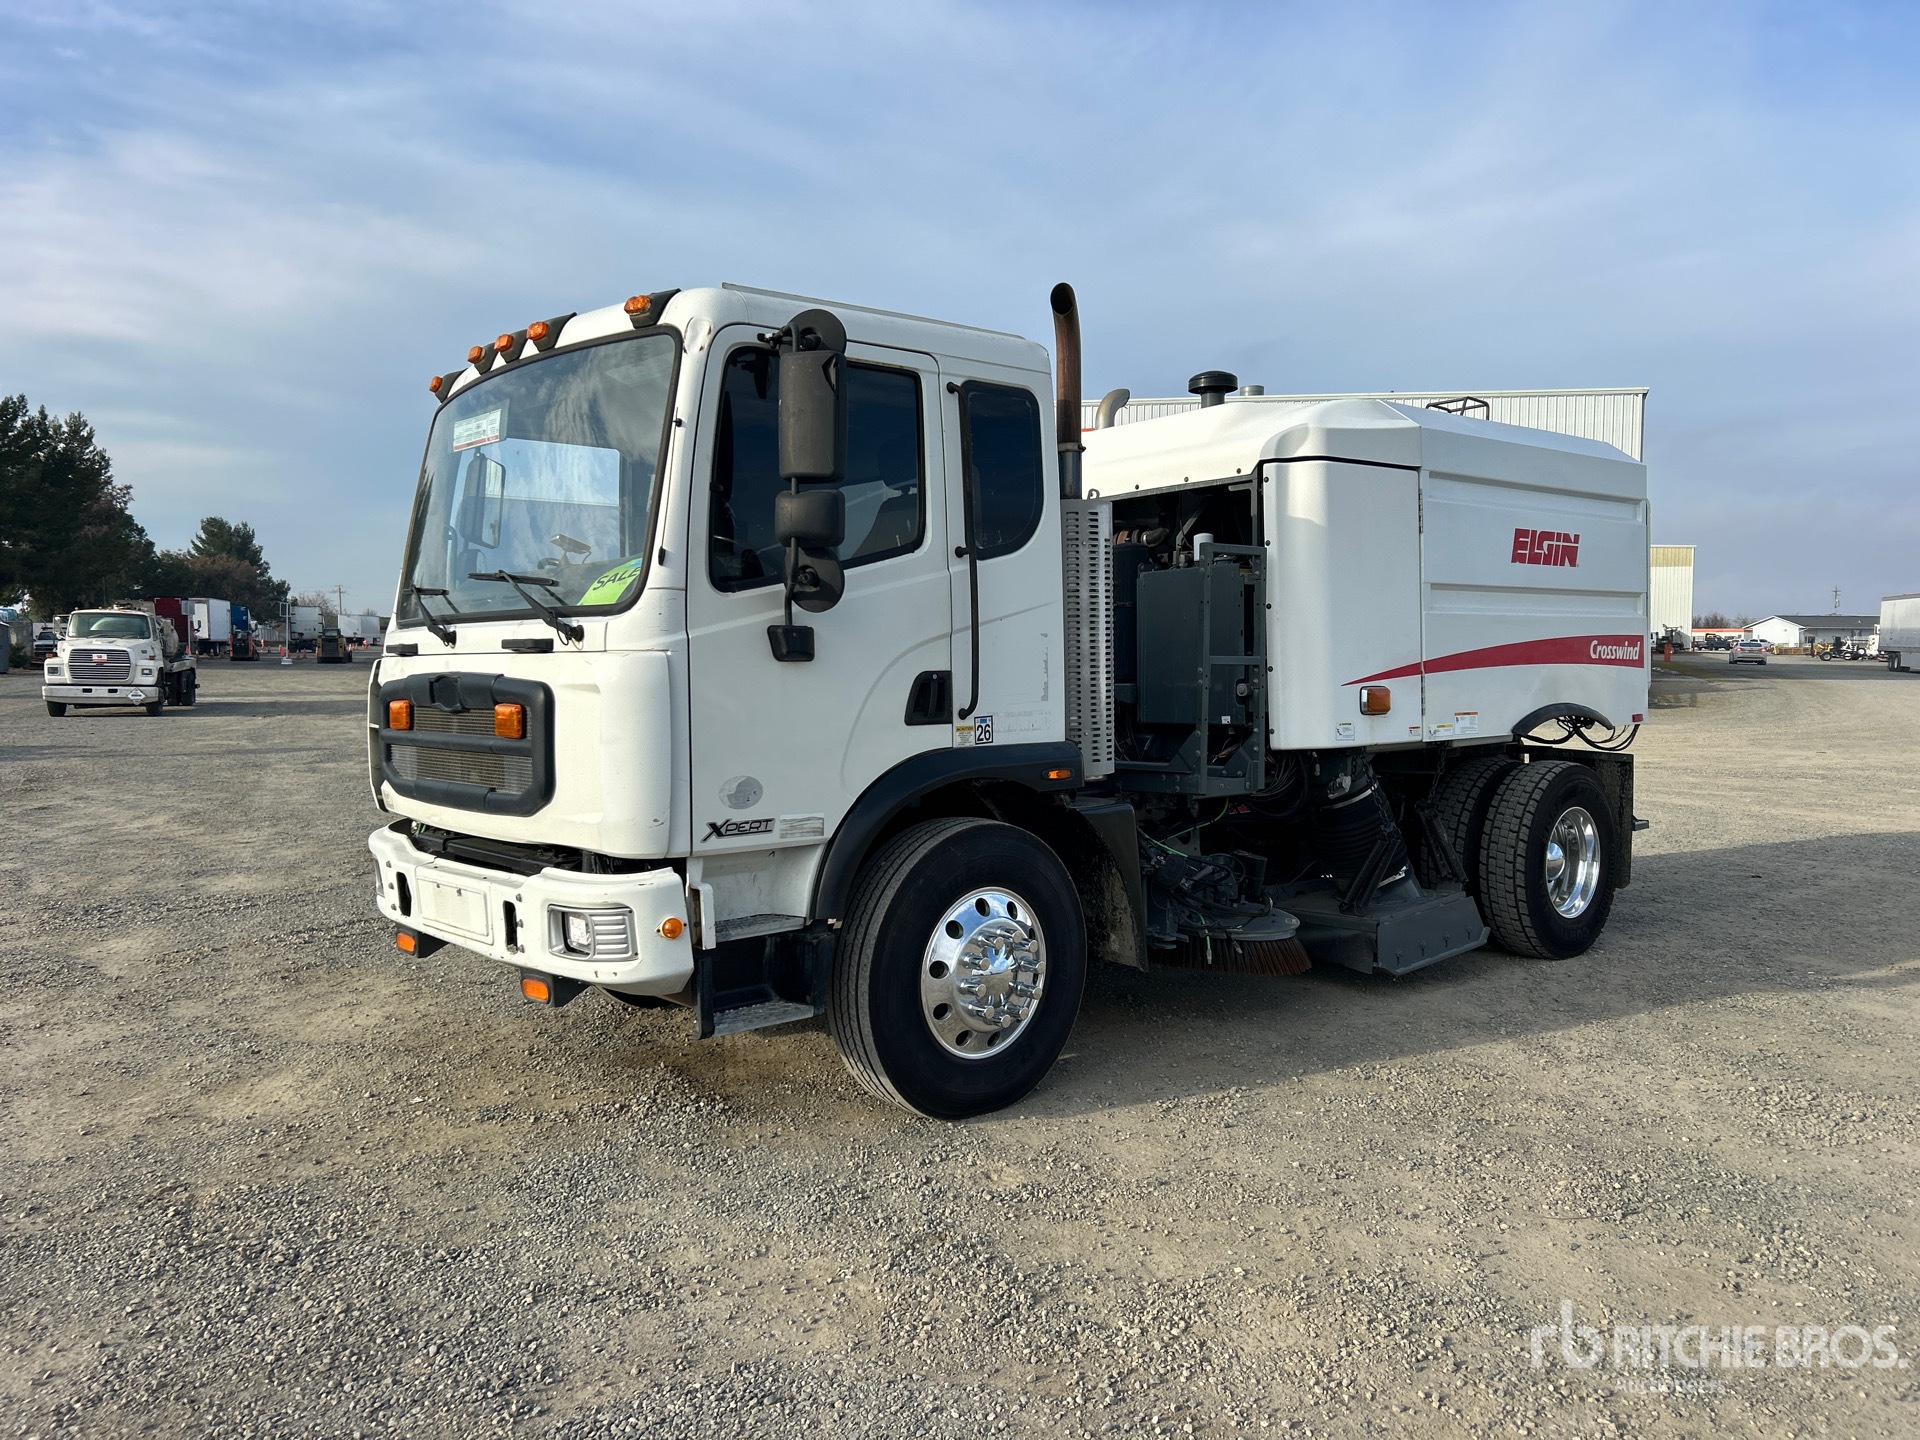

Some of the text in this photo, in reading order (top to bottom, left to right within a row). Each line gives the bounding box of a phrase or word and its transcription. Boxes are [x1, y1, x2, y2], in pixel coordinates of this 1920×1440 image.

[1511, 527, 1580, 567] ELGIN
[1590, 640, 1641, 660] Crosswind
[976, 723, 991, 742] 26
